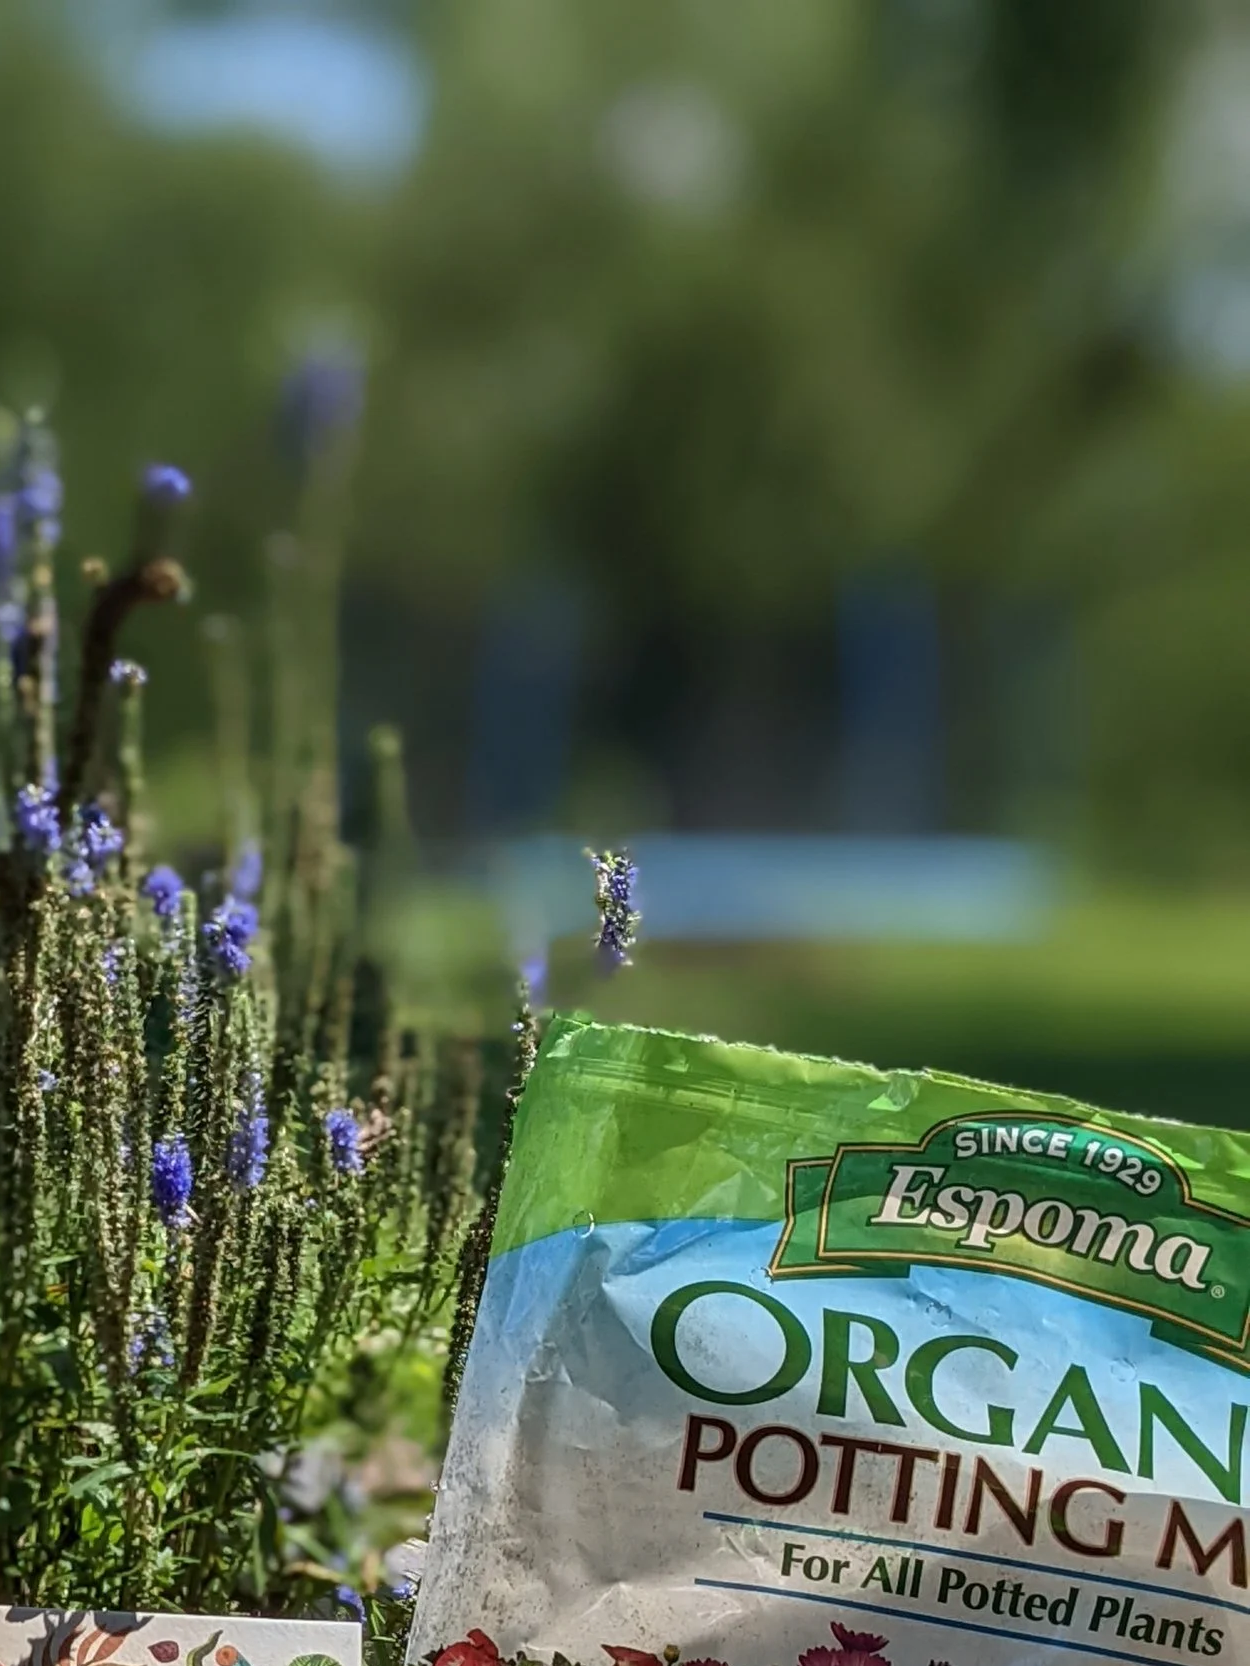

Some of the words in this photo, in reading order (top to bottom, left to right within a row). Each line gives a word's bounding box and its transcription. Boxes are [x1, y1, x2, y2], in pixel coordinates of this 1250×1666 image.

[955, 1126, 1074, 1159] SINCE
[1084, 1140, 1162, 1196] 1929
[870, 1164, 1212, 1290] Espoma
[651, 1280, 1250, 1506] ORGAN
[676, 1414, 1126, 1558] POTTING
[781, 1542, 850, 1583] For
[860, 1555, 924, 1599] All
[937, 1566, 1080, 1627] Potted
[1088, 1596, 1225, 1657] Plants
